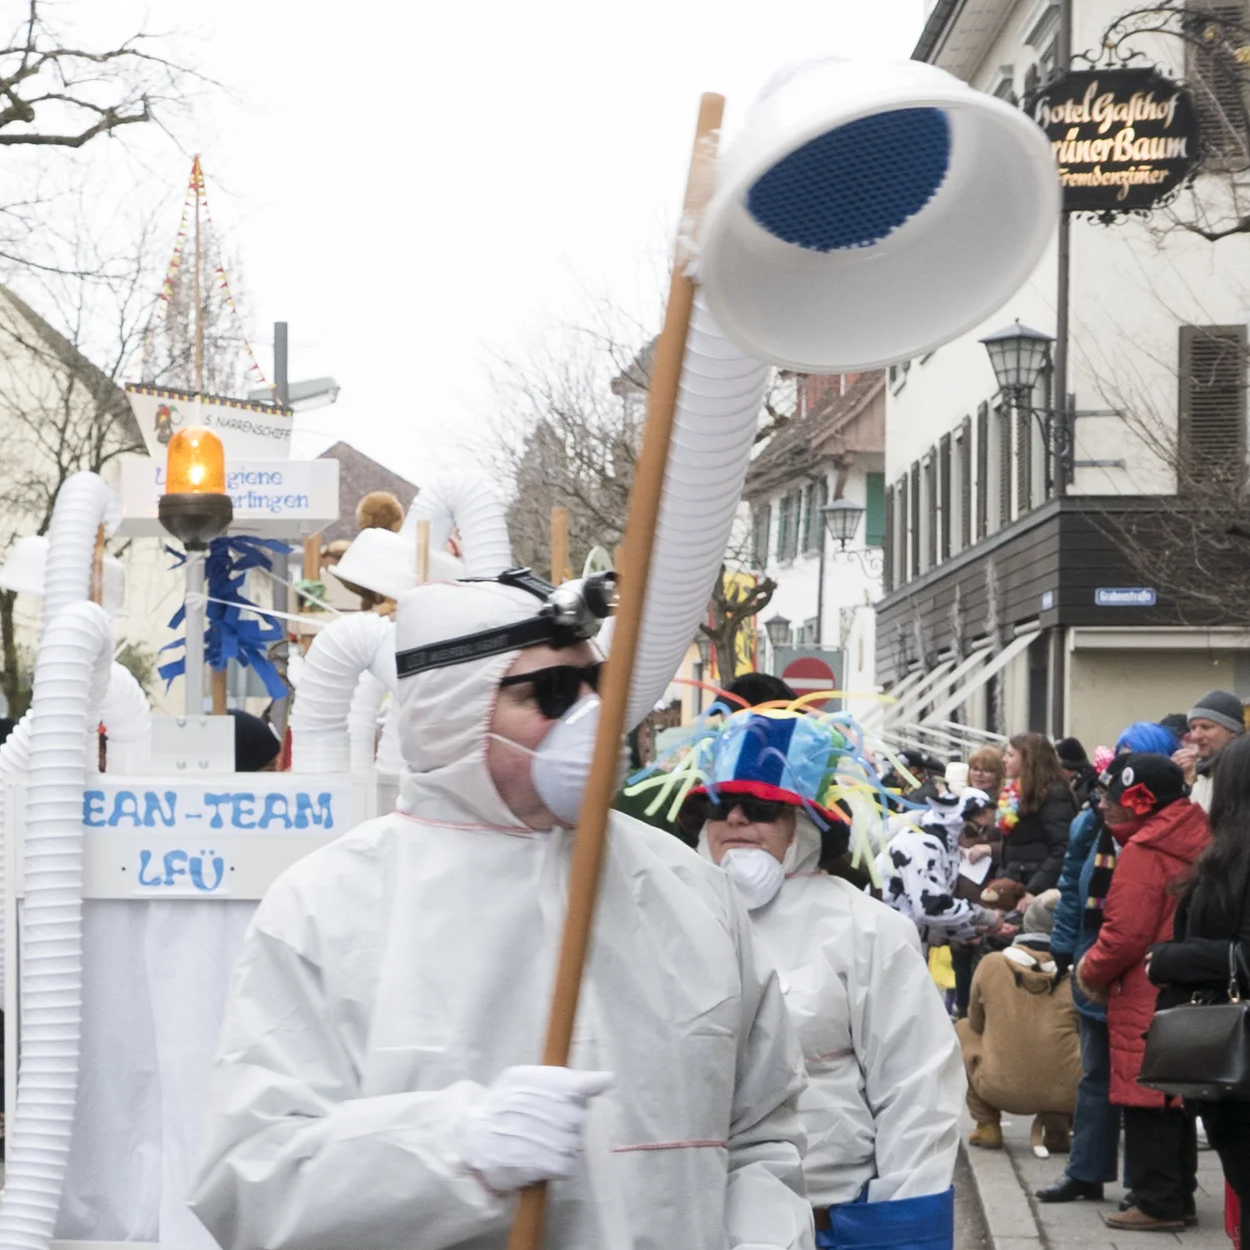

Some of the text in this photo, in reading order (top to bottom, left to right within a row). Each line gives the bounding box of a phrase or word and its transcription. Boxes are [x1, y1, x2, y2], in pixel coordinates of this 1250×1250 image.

[1112, 127, 1188, 163] Baum
[216, 415, 291, 441] NARRENSCHIFF
[138, 849, 225, 892] LFÜ
